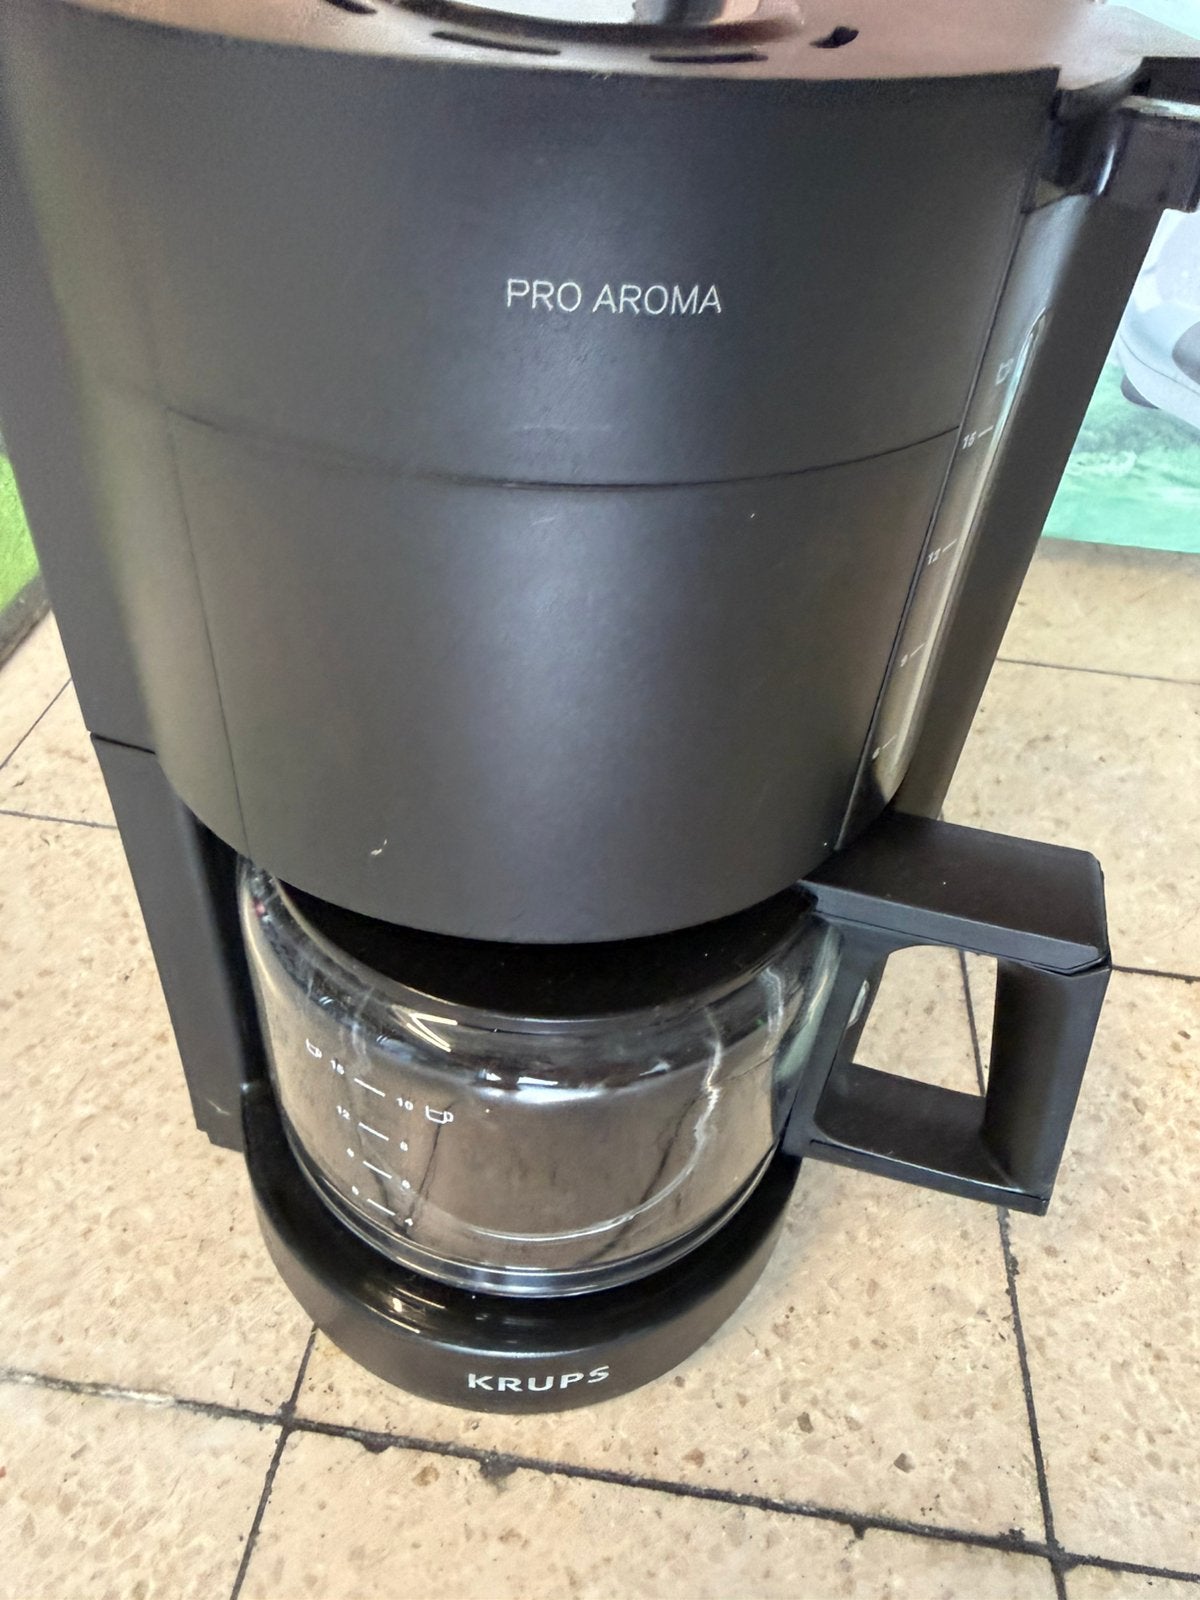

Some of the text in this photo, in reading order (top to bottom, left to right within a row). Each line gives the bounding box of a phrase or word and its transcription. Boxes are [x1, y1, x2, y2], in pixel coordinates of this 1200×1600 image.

[506, 277, 723, 315] PRO AROMA
[396, 1097, 414, 1112] 10
[467, 1364, 611, 1393] KRUPS
